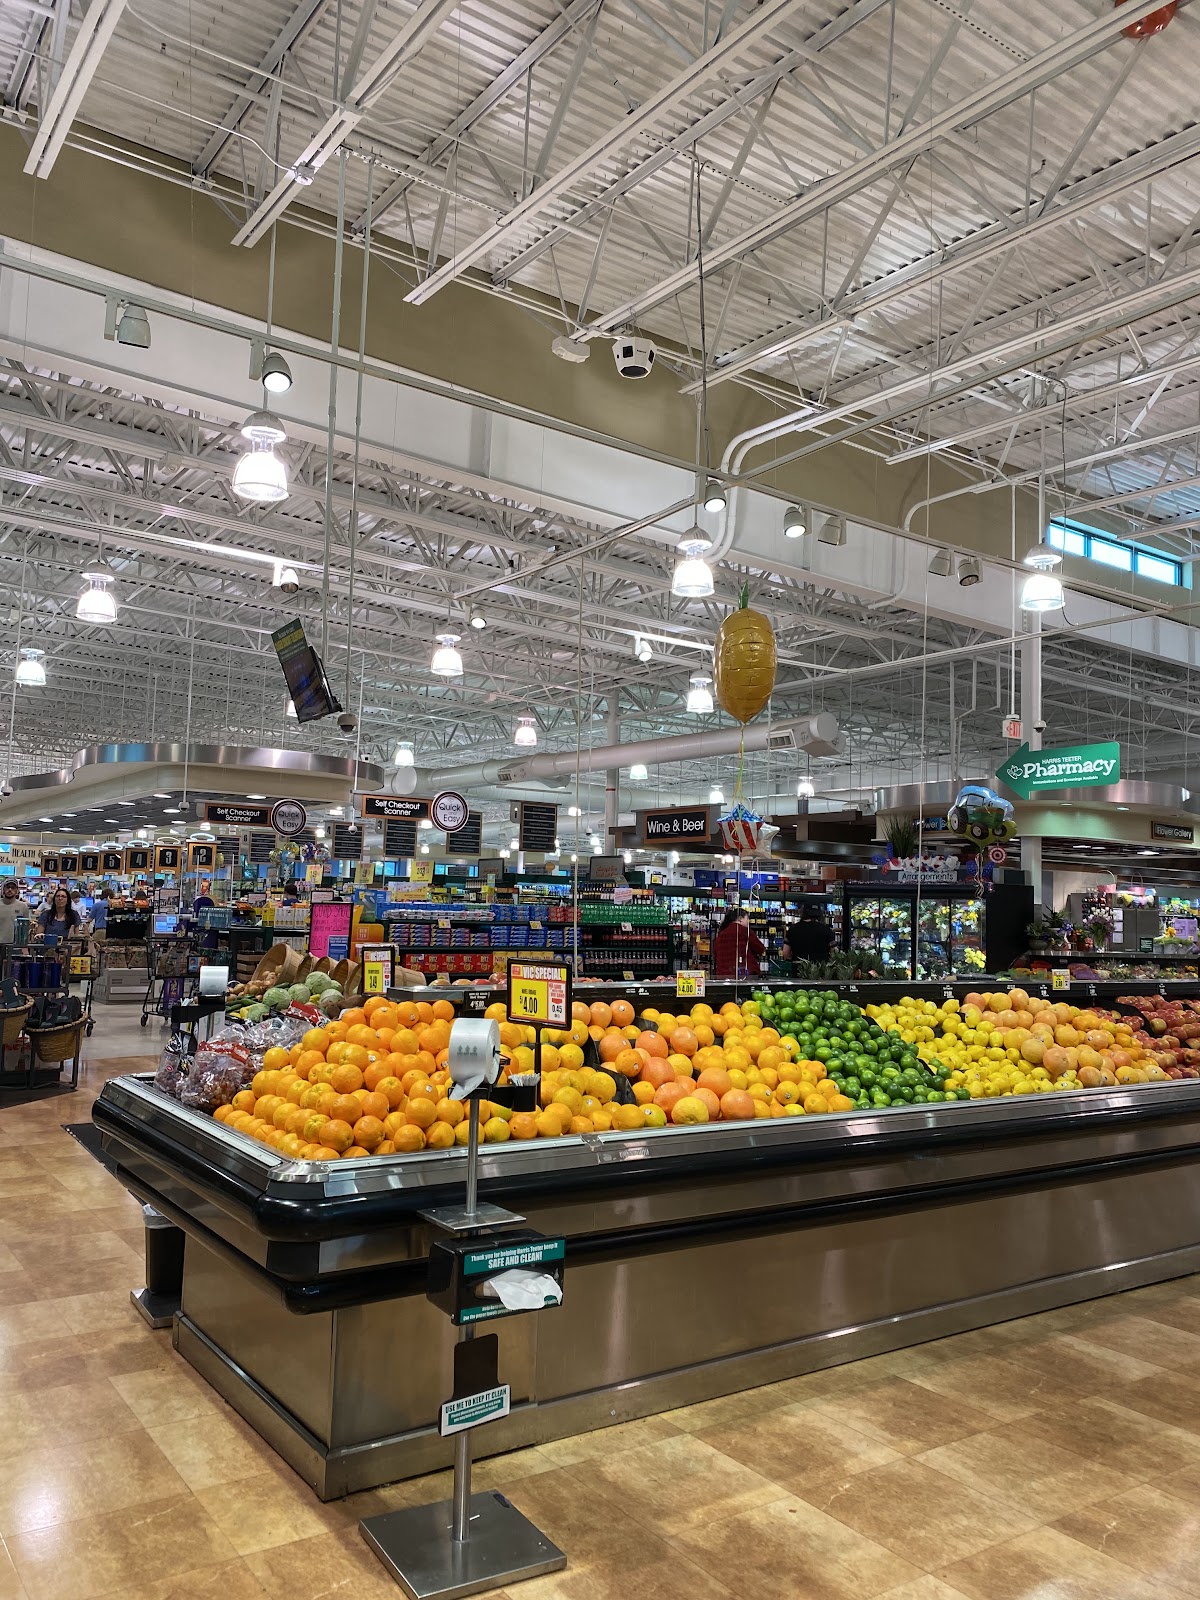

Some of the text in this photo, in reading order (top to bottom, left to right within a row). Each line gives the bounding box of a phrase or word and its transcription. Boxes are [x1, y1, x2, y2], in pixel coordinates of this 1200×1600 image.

[1023, 758, 1116, 778] Pharmacy
[388, 802, 420, 810] Checkout
[440, 802, 461, 812] Quick
[229, 808, 260, 817] Checkout
[278, 810, 300, 818] Quick
[384, 808, 412, 816] Scanner
[282, 820, 298, 828] Easy
[444, 814, 460, 824] Easy
[648, 818, 704, 833] Wine & Beer
[1174, 828, 1192, 839] Gallery
[136, 854, 142, 866] 4
[166, 851, 172, 864] 3
[199, 849, 207, 862] 2
[48, 860, 54, 870] 8
[67, 859, 72, 869] 7
[87, 858, 92, 868] 6
[109, 856, 115, 868] 5
[902, 872, 953, 882] Arrangements
[523, 966, 562, 980] VIC SPECIAL
[471, 1254, 484, 1262] Thank
[488, 1251, 542, 1269] SAFE AND CLEAN!
[446, 1404, 455, 1413] USE
[457, 1402, 464, 1410] ME
[465, 1399, 472, 1407] TO
[473, 1394, 484, 1404] KEEP
[492, 1388, 507, 1399] CLEAN
